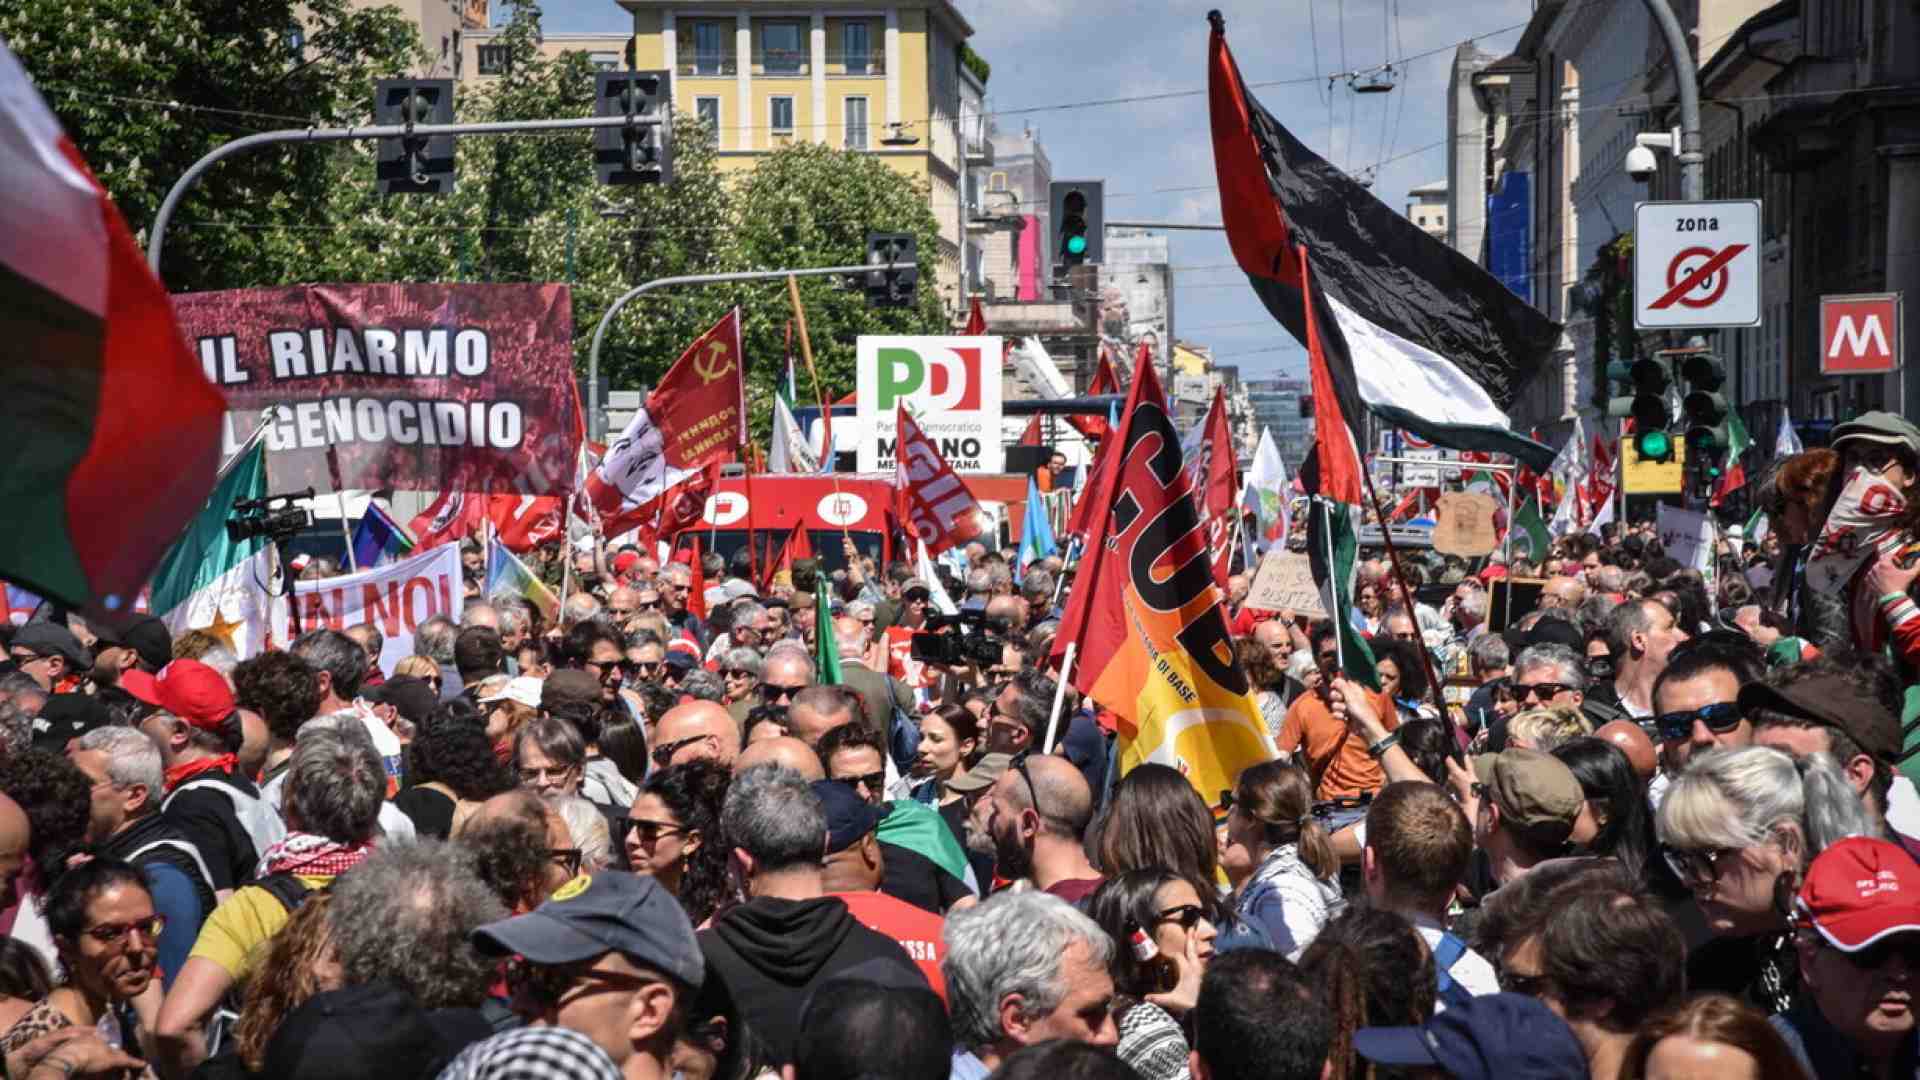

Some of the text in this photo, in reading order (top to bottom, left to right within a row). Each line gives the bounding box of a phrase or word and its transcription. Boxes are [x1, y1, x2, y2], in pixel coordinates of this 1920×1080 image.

[1676, 217, 1719, 231] zona
[200, 328, 488, 383] IL RIARMO
[1828, 314, 1890, 358] M
[877, 348, 981, 410] PD
[261, 397, 521, 451] GENOCIDIO
[1157, 660, 1199, 703] DI BASE
[899, 940, 937, 960] SSA
